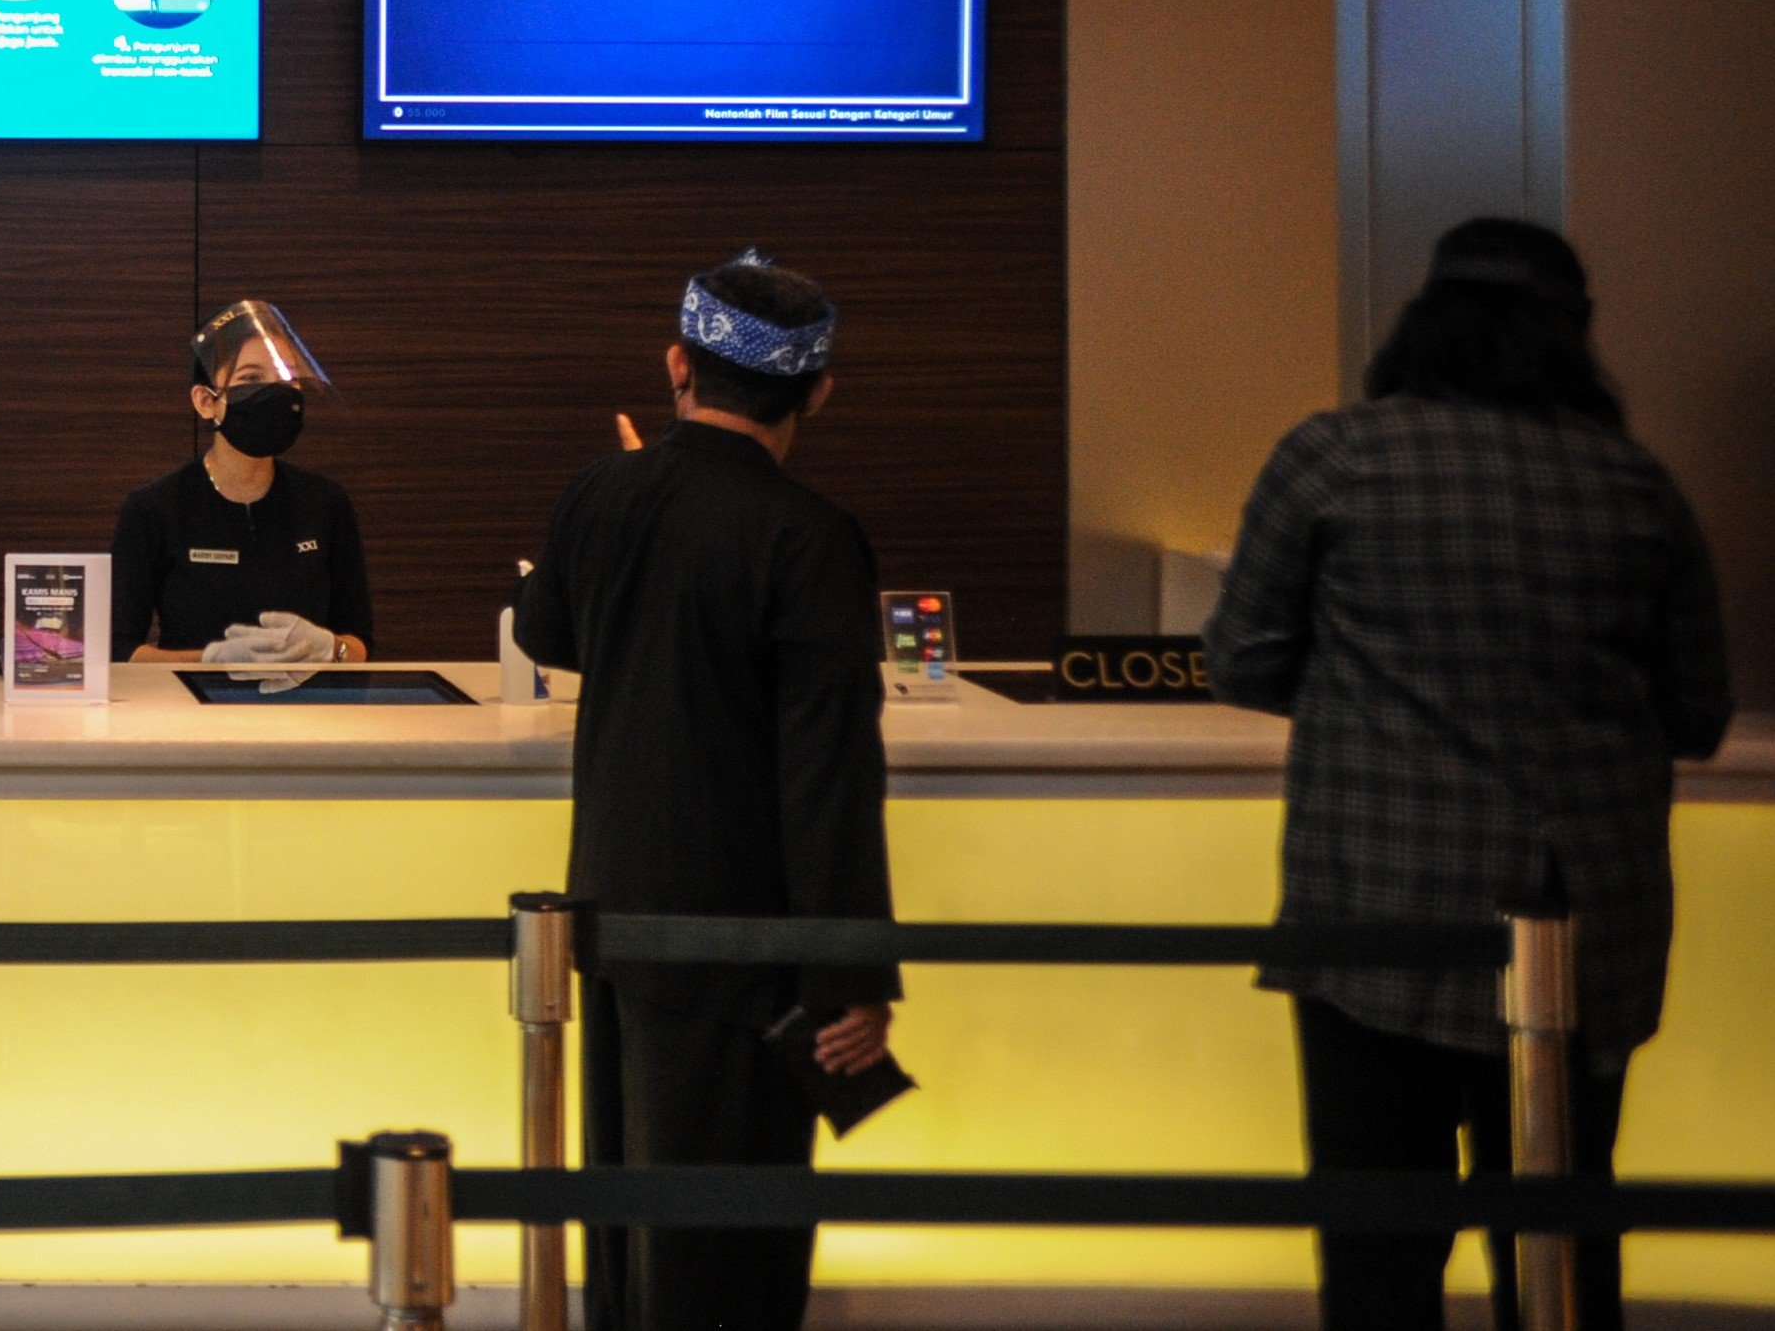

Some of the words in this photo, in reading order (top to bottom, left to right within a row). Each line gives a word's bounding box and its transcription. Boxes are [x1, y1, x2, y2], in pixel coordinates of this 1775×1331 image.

[764, 109, 788, 120] Film
[791, 109, 826, 120] Sesuai
[828, 109, 872, 122] Dengan
[873, 109, 920, 122] Kategori
[921, 110, 954, 121] Umur
[1062, 650, 1207, 689] CLOSE
